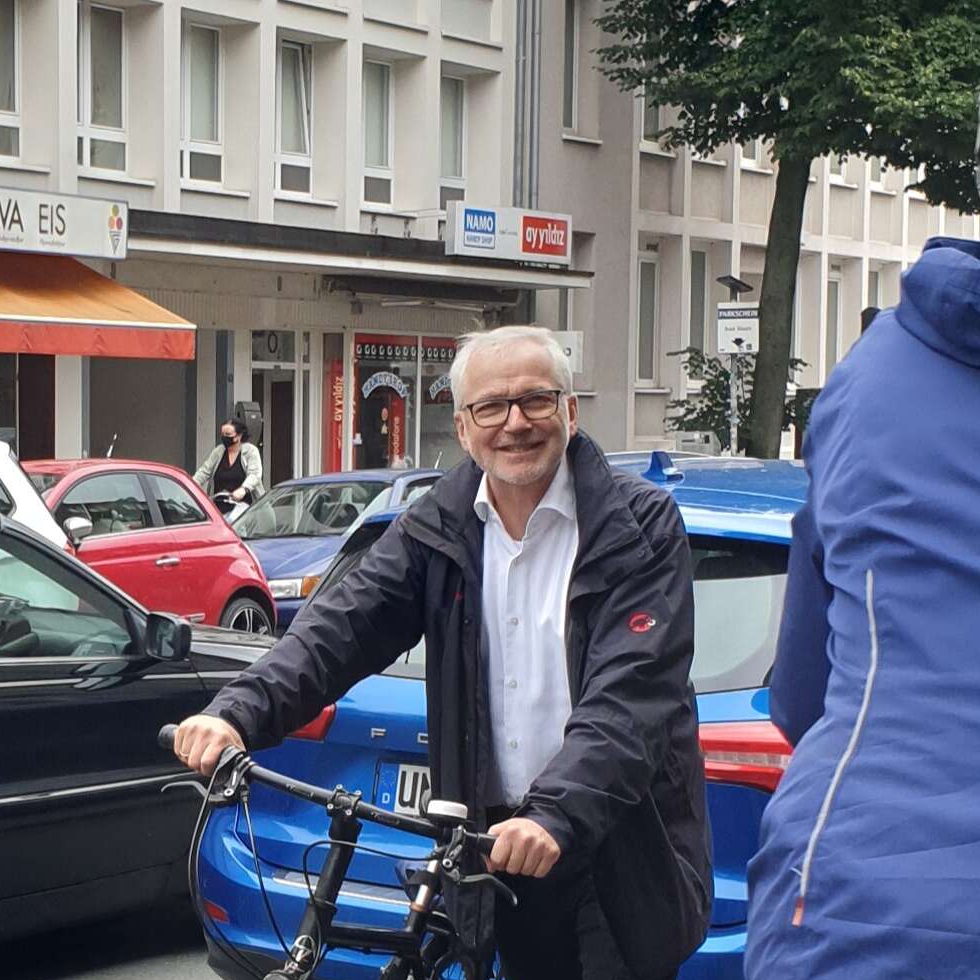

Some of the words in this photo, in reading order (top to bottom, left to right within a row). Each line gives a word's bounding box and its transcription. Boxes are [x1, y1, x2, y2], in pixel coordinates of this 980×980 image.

[38, 203, 66, 236] EIS
[466, 213, 494, 233] NAMO
[392, 416, 401, 460] odafone
